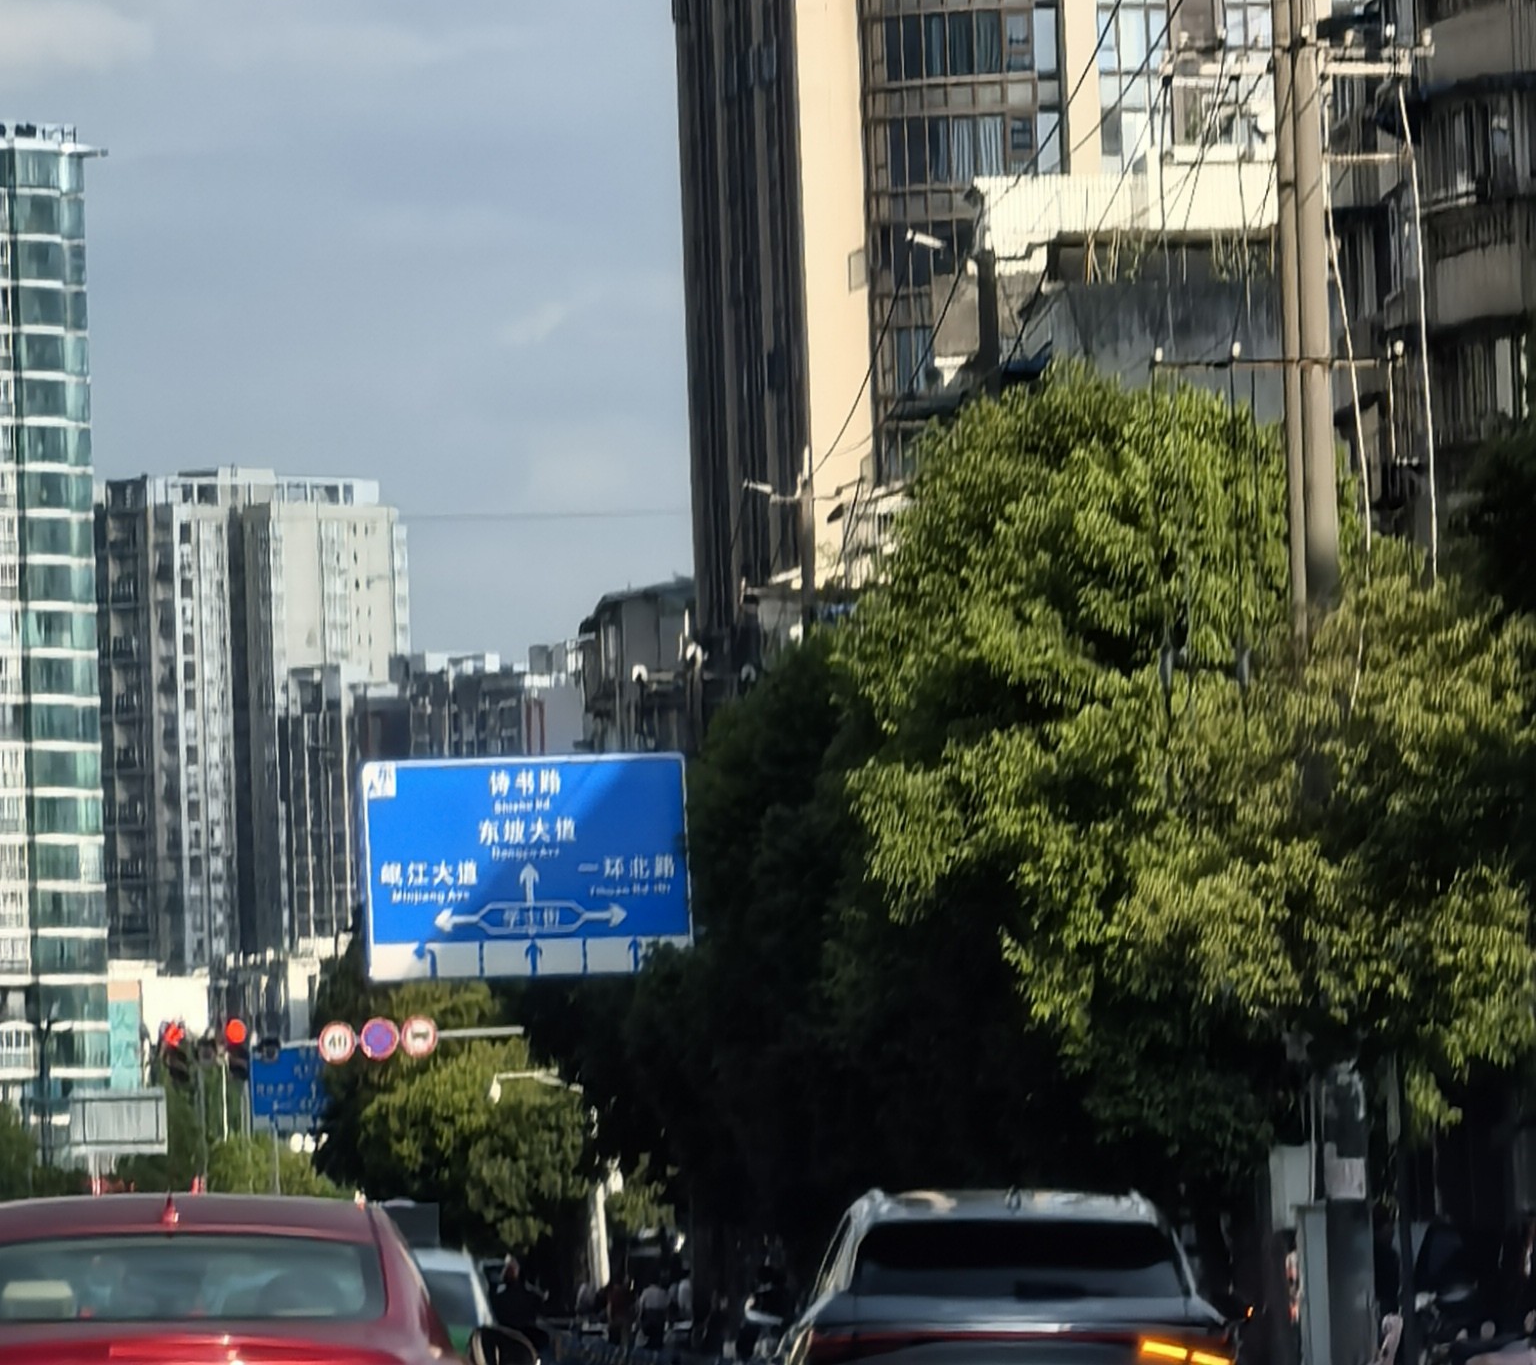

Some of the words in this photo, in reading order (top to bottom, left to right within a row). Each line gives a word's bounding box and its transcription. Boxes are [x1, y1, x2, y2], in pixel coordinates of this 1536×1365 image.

[478, 816, 577, 847] 东坡大道
[380, 858, 479, 888] 岷江大道
[576, 852, 676, 881] 一环北路
[392, 889, 446, 906] Minjiang
[328, 1033, 348, 1050] 40
